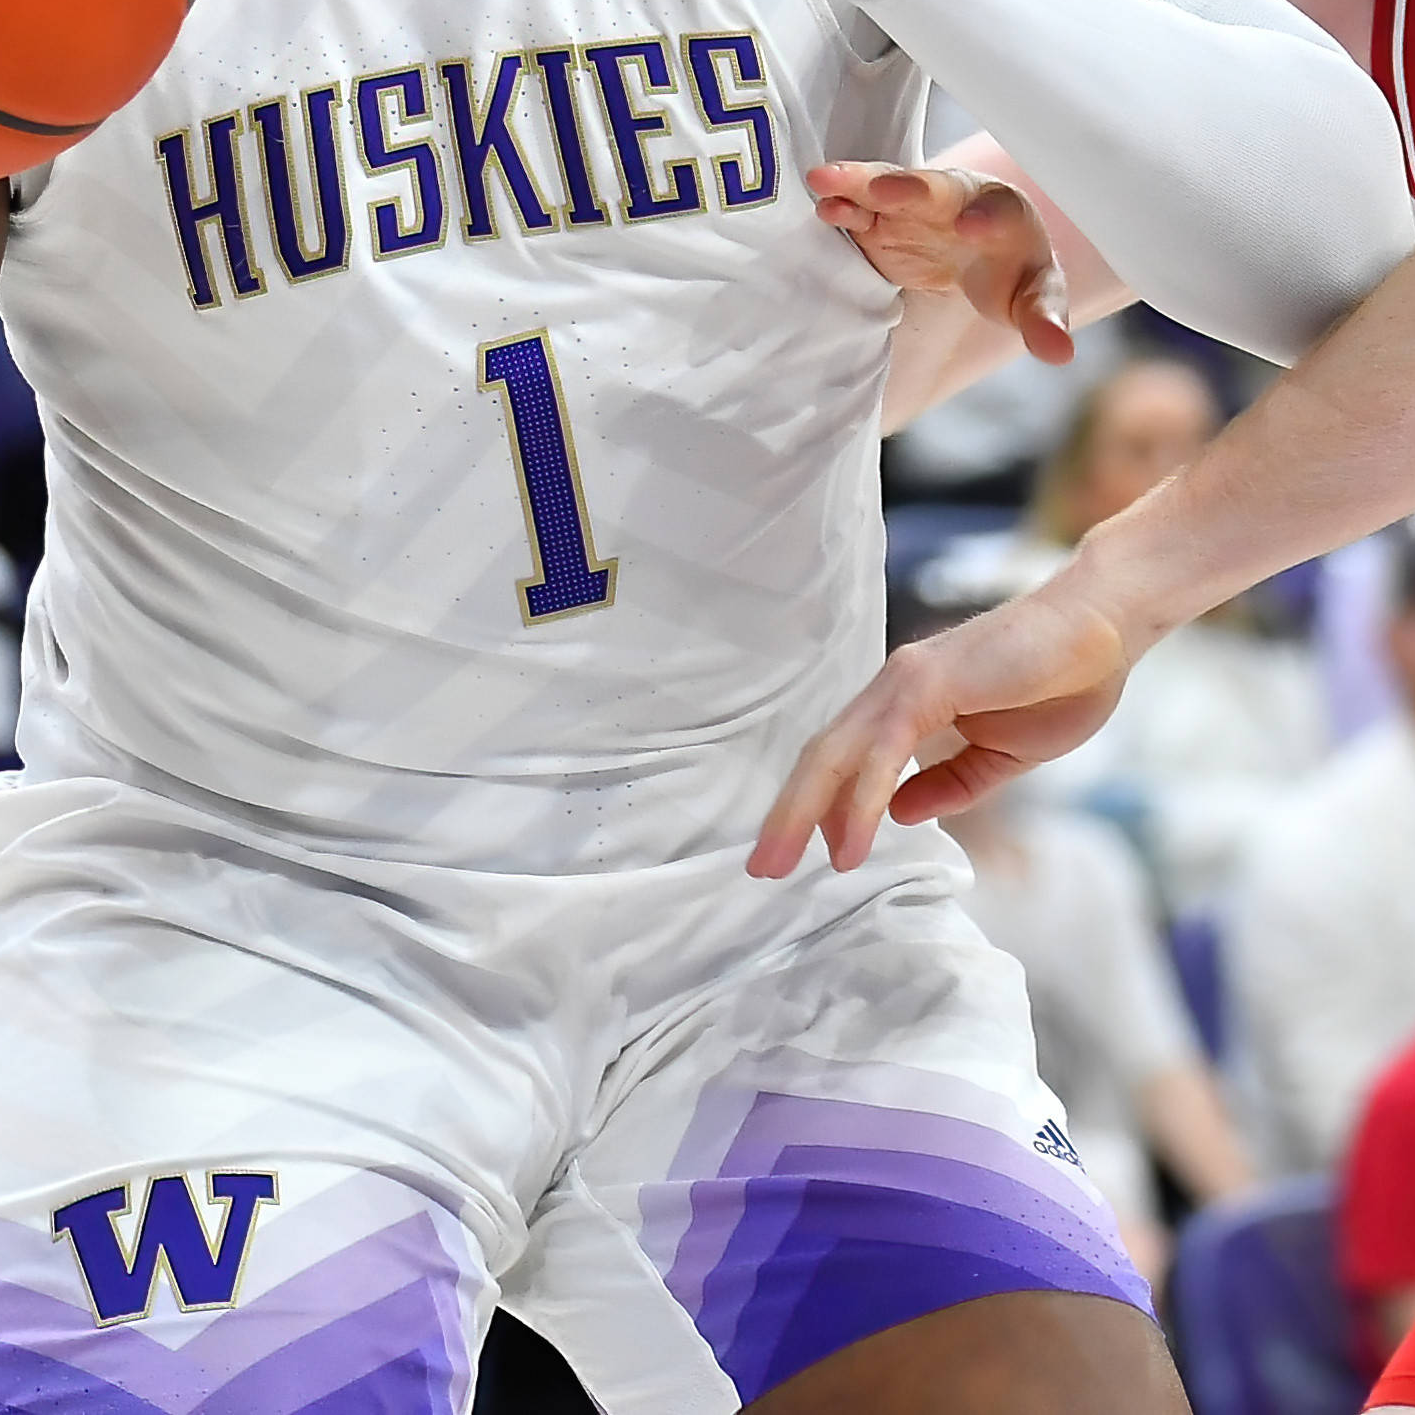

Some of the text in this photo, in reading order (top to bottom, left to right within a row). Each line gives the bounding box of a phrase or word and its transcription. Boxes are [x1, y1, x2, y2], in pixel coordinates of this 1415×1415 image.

[155, 30, 781, 310] HUSKIES
[476, 327, 618, 628] 1
[50, 1169, 280, 1328] W
